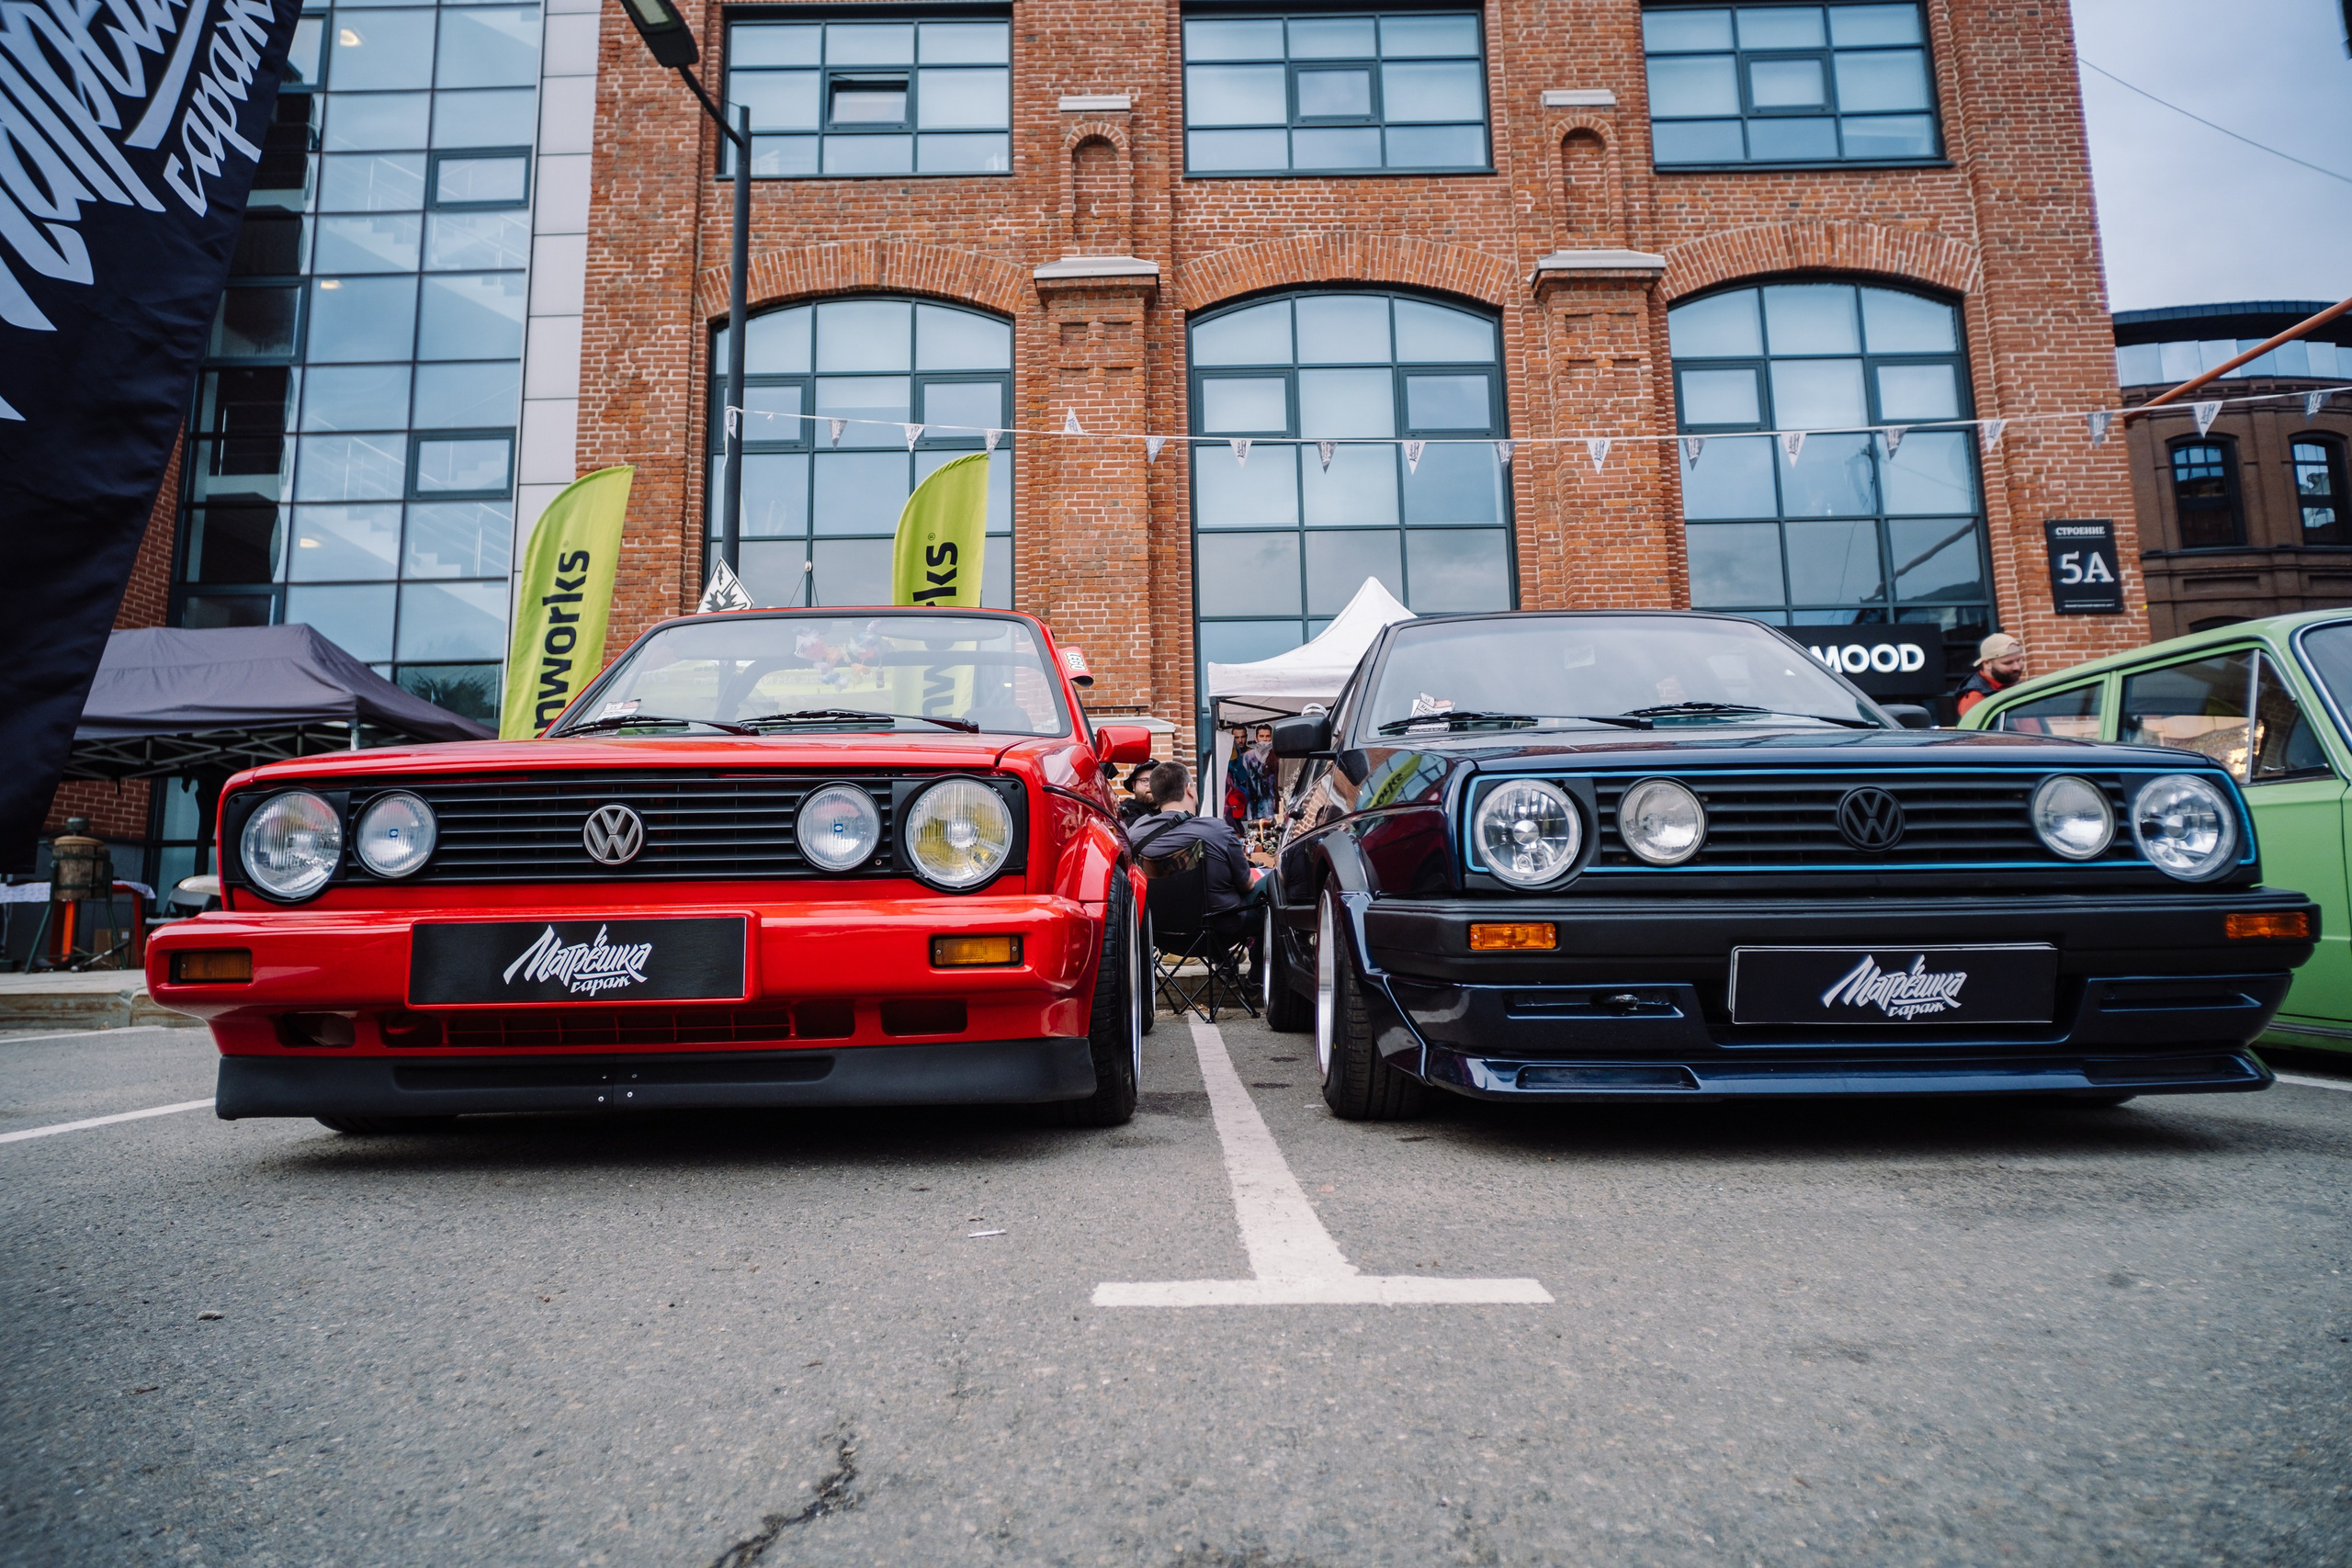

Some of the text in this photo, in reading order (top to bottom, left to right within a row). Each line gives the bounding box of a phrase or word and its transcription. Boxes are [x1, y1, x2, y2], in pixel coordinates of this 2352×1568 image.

[2055, 525, 2106, 536] СТРОЕНИЕ
[2060, 550, 2115, 584] 5А
[535, 549, 591, 739] nworks
[1809, 643, 1926, 674] MOOD
[1064, 651, 1088, 671] LEGO
[583, 805, 643, 864] VW
[503, 923, 653, 987] Матрёшка
[570, 975, 632, 997] гараж
[1887, 1000, 1947, 1021] гараж
